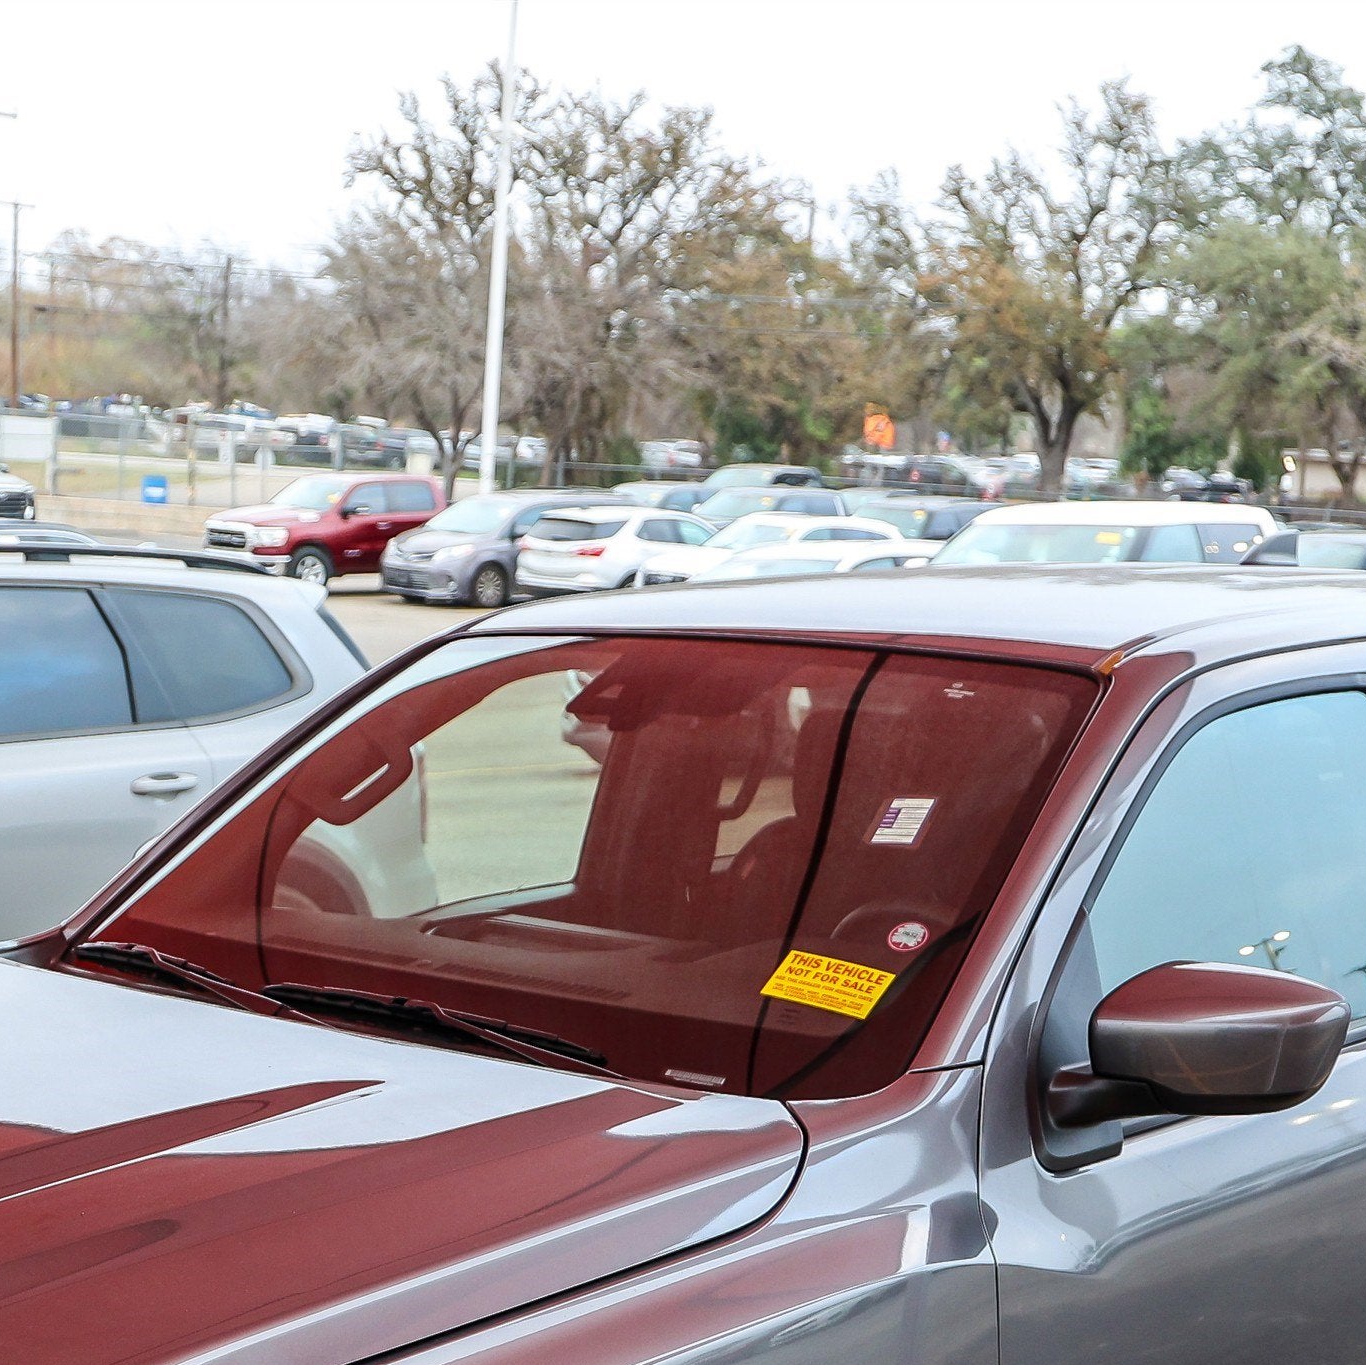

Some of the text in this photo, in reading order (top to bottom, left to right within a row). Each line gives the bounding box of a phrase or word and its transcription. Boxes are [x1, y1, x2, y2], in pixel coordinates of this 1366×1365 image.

[785, 966, 811, 978] NOT
[812, 971, 838, 985] FOR
[841, 980, 876, 994] SALE
[790, 953, 888, 986] THIS VEHICLE
